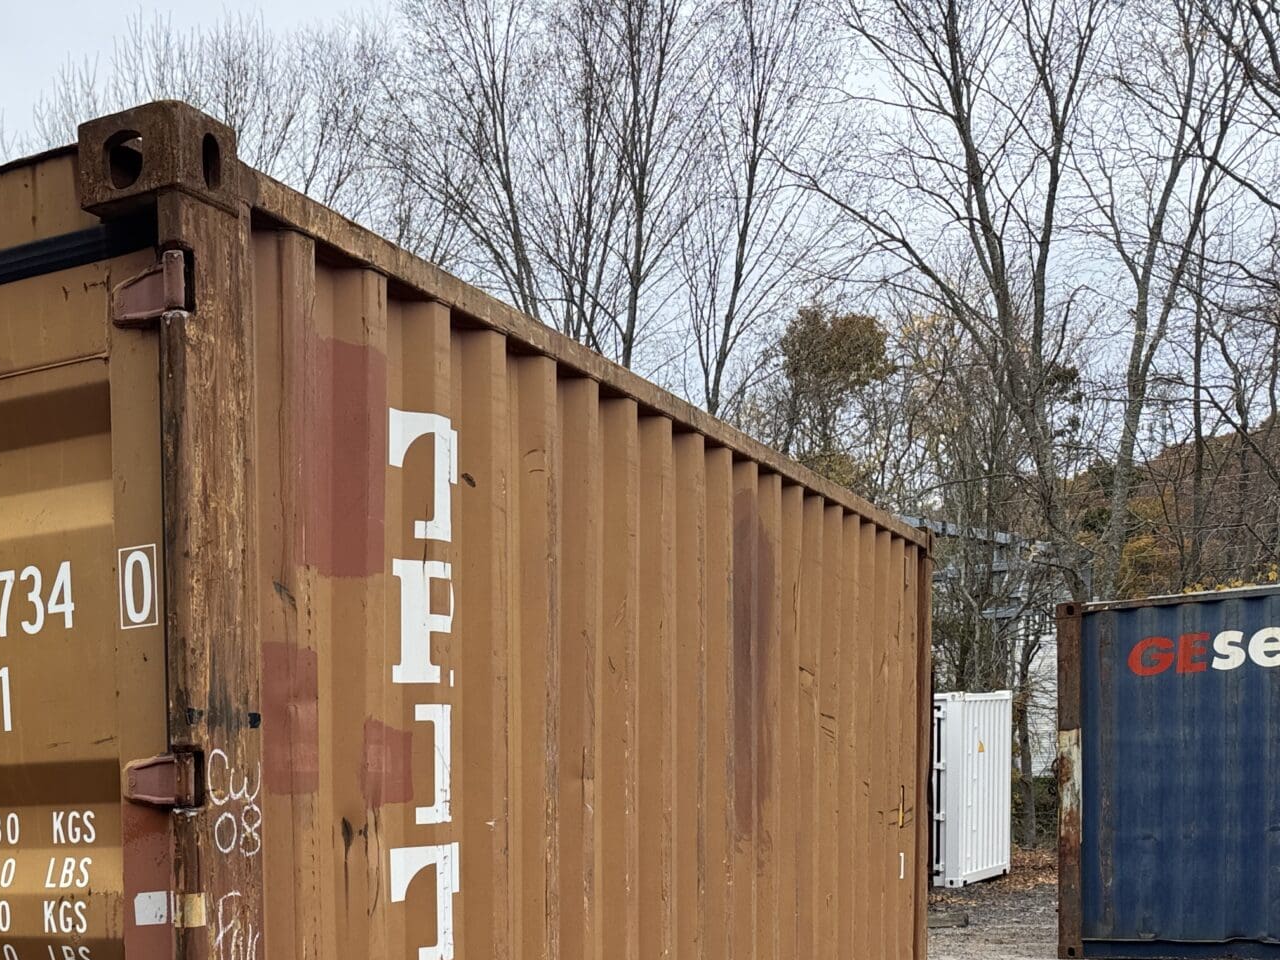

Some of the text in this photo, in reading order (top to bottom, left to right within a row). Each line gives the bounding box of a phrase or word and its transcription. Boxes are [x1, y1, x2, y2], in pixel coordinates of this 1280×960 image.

[124, 551, 153, 625] 0
[52, 810, 96, 844] KGS
[44, 856, 93, 889] LBS
[43, 900, 88, 934] KGS
